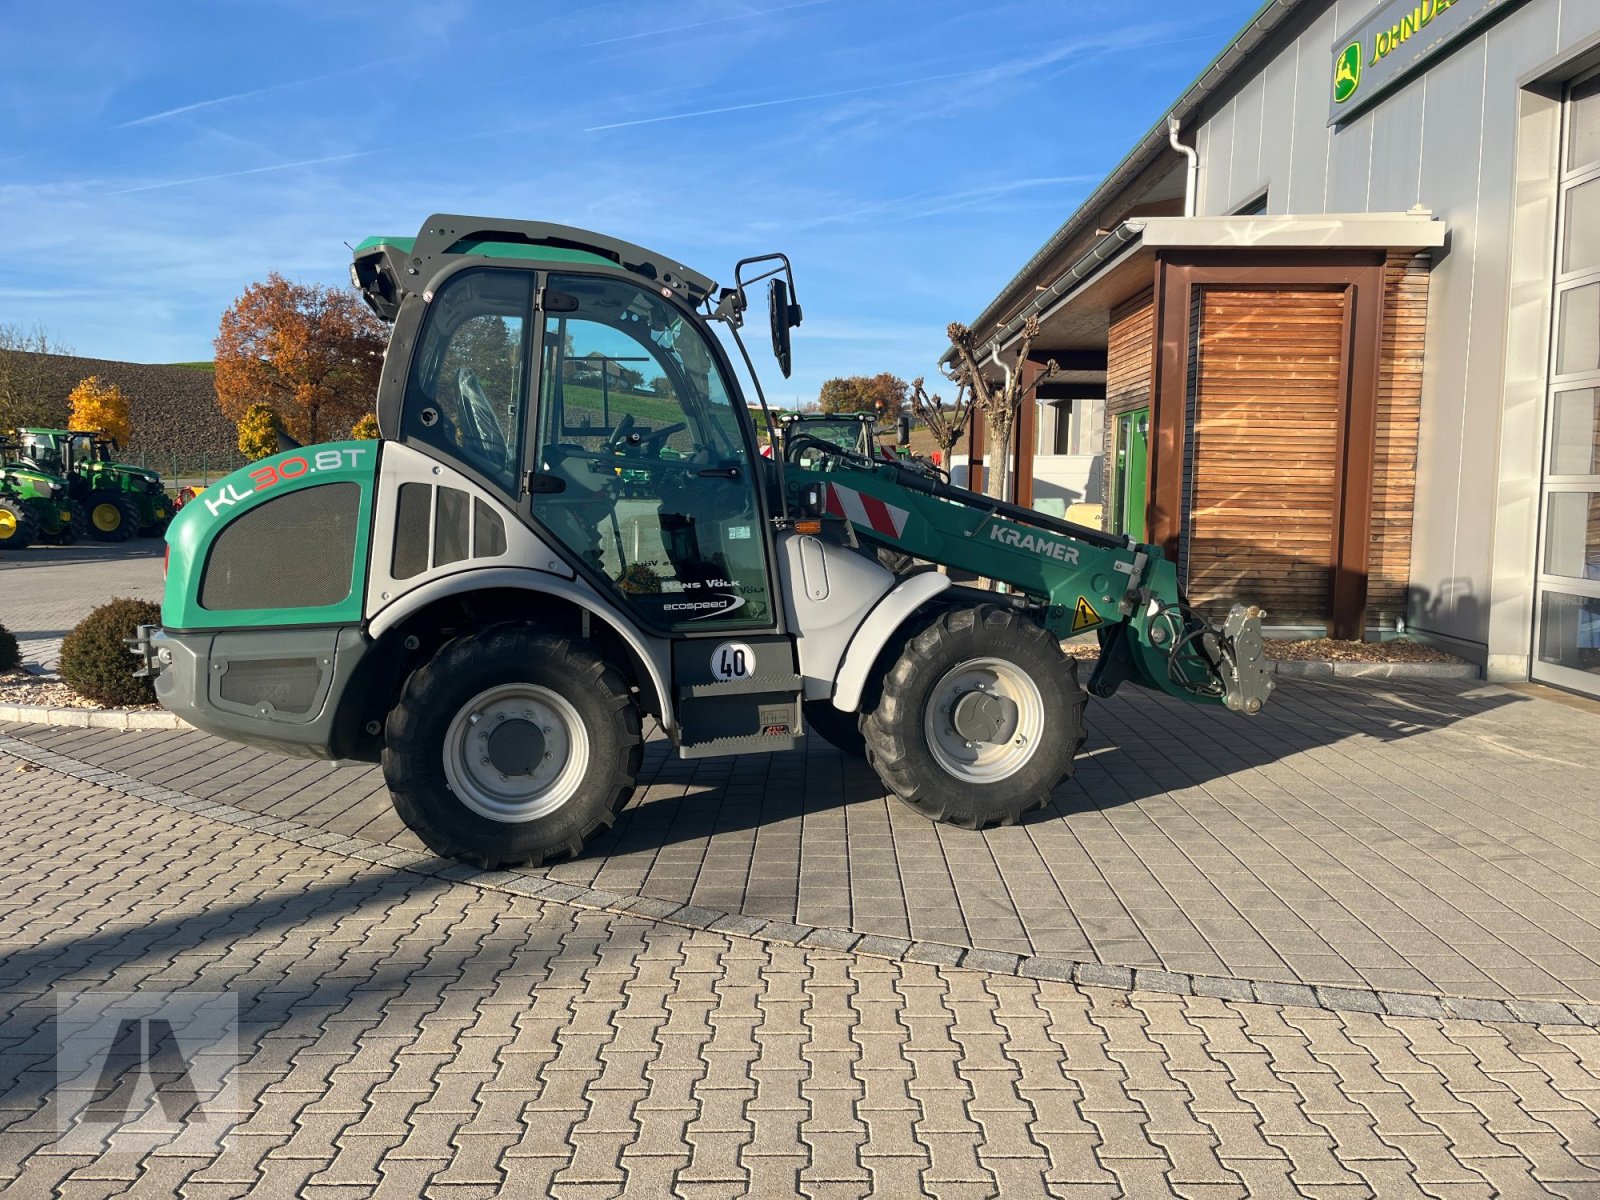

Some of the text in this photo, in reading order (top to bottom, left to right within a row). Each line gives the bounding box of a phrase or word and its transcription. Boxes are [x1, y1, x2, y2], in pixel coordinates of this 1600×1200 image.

[1367, 0, 1458, 67] JOHN DE
[989, 524, 1080, 565] KRAMER
[663, 600, 727, 611] ecospeed
[720, 649, 746, 677] 40
